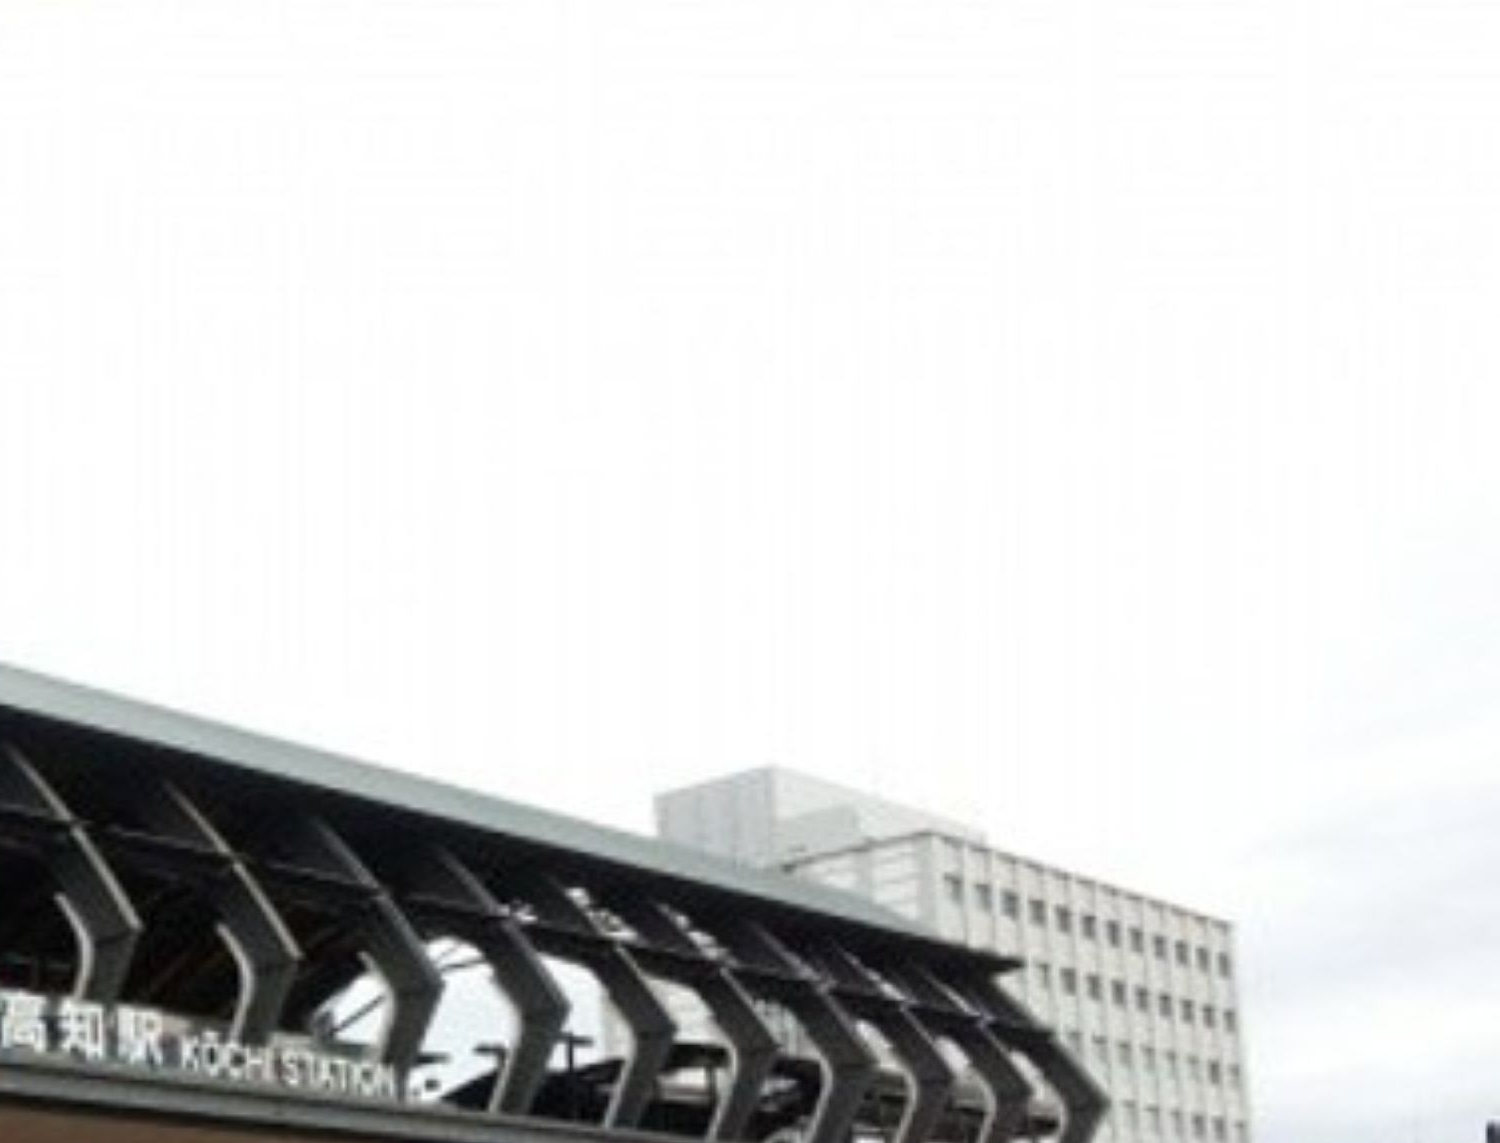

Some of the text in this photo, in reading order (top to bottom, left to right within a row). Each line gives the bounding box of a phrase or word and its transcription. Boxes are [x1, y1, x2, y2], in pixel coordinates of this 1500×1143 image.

[0, 989, 163, 1064] 高知駅
[281, 1051, 394, 1097] STATION
